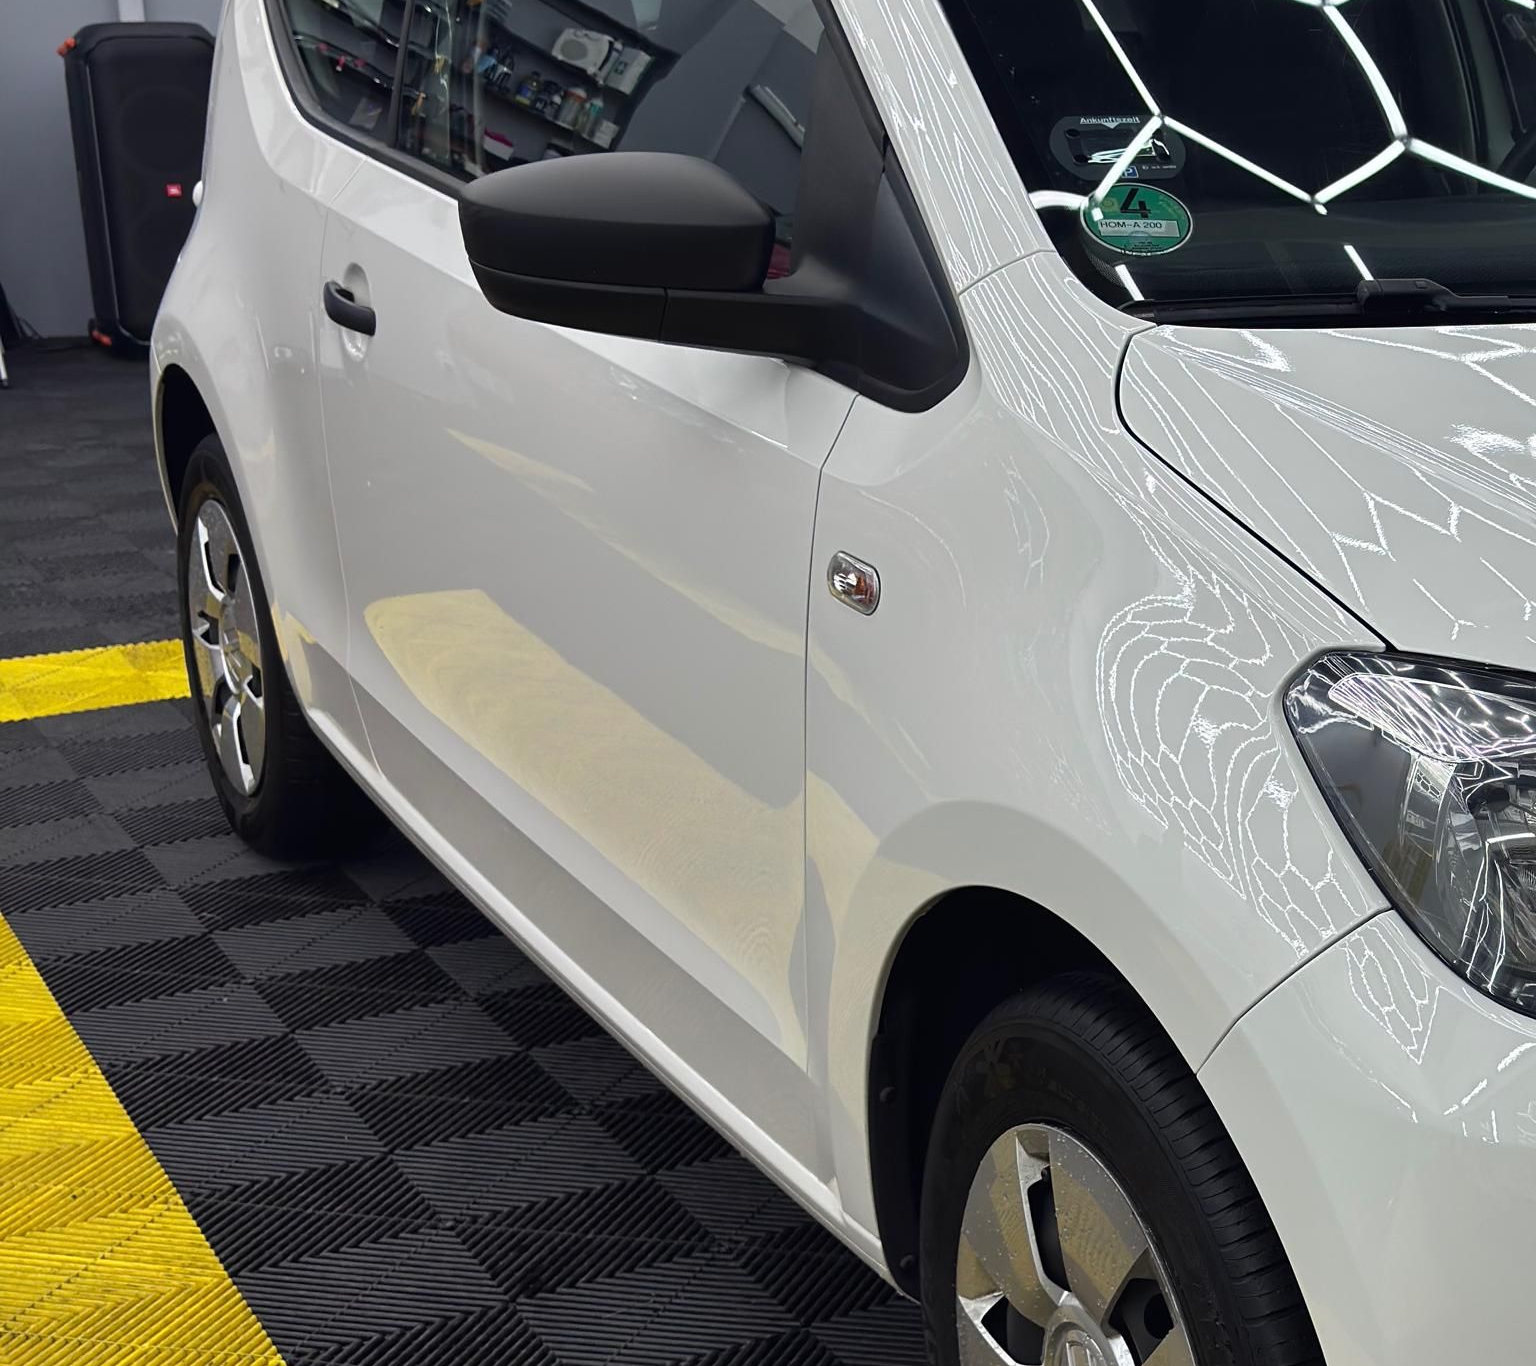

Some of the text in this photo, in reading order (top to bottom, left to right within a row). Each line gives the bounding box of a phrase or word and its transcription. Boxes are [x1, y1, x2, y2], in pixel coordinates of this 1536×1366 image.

[1120, 188, 1151, 218] 4
[1100, 221, 1163, 229] HOM-A 200
